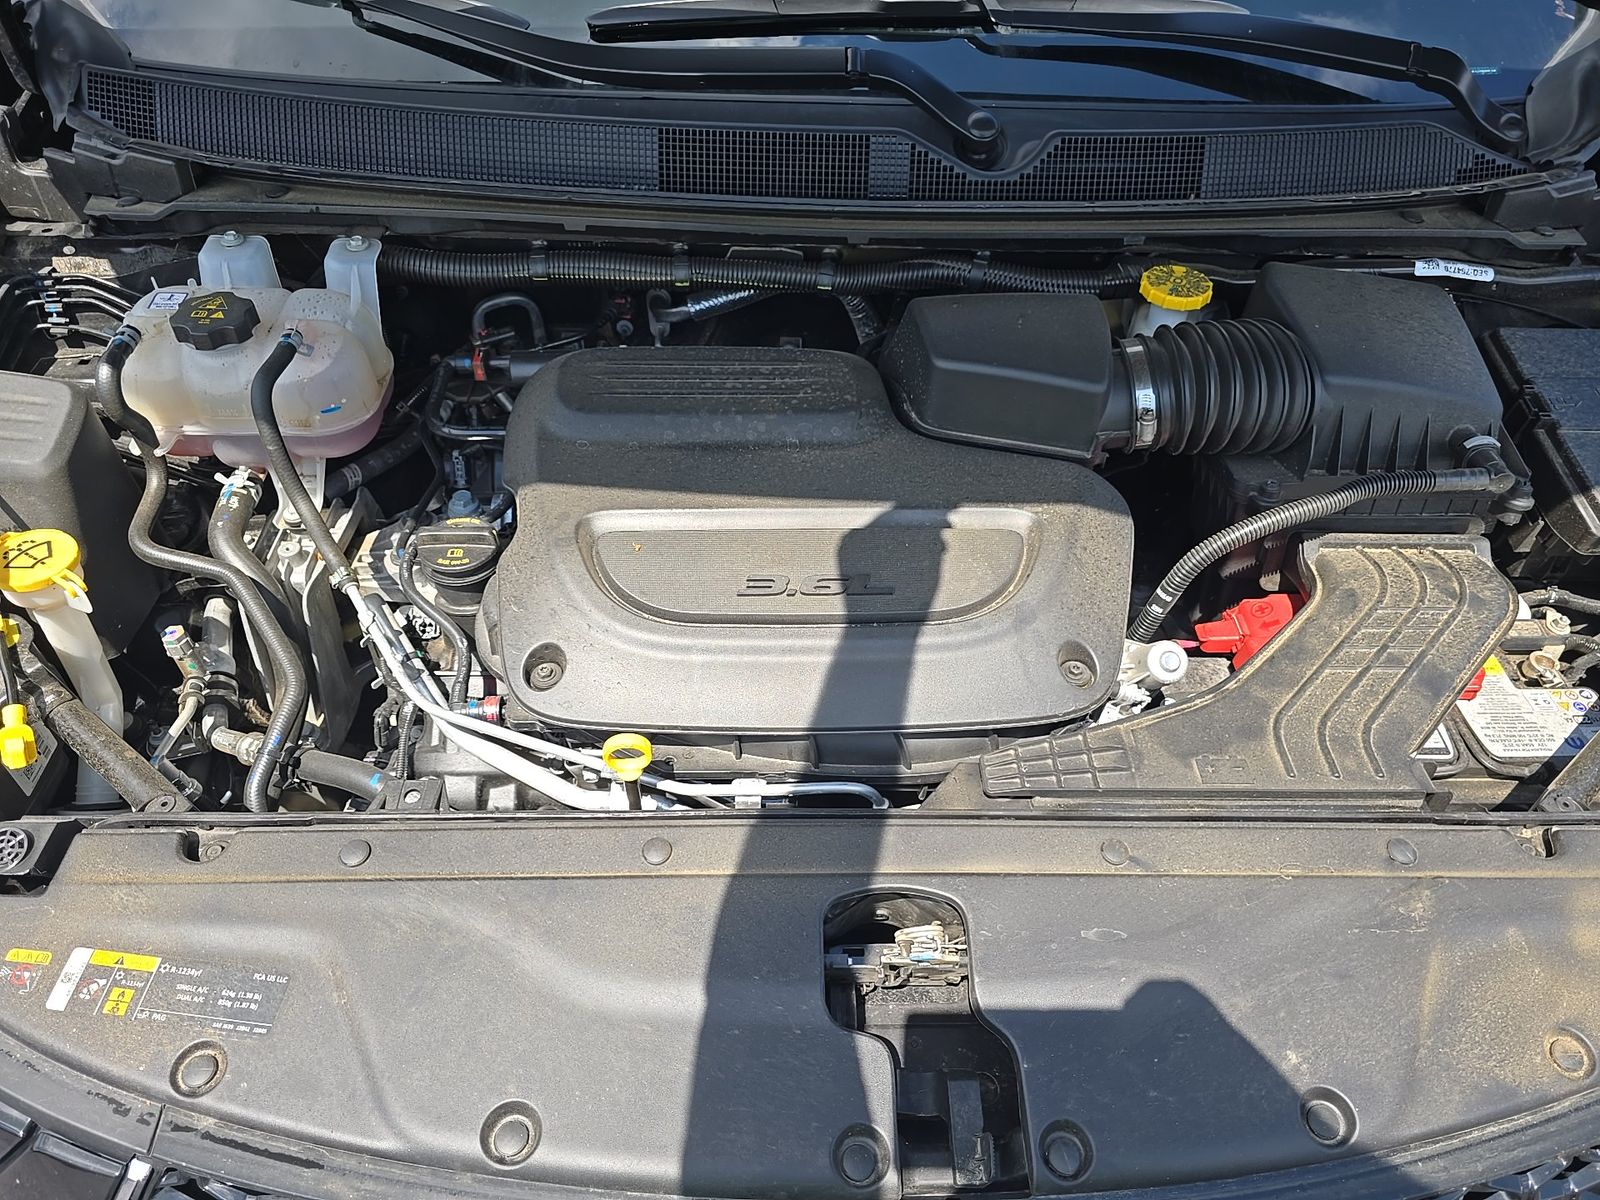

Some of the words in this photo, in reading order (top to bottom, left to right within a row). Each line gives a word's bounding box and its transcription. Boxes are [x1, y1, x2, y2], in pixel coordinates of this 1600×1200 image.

[737, 574, 895, 597] 3.6L
[170, 966, 203, 978] R-1234yf
[253, 972, 267, 981] FCA
[267, 974, 276, 982] US
[277, 975, 289, 984] LLC
[175, 983, 198, 992] SINGLE
[198, 986, 209, 994] A/C
[176, 993, 193, 1001] DUAL
[151, 1012, 167, 1021] PAG
